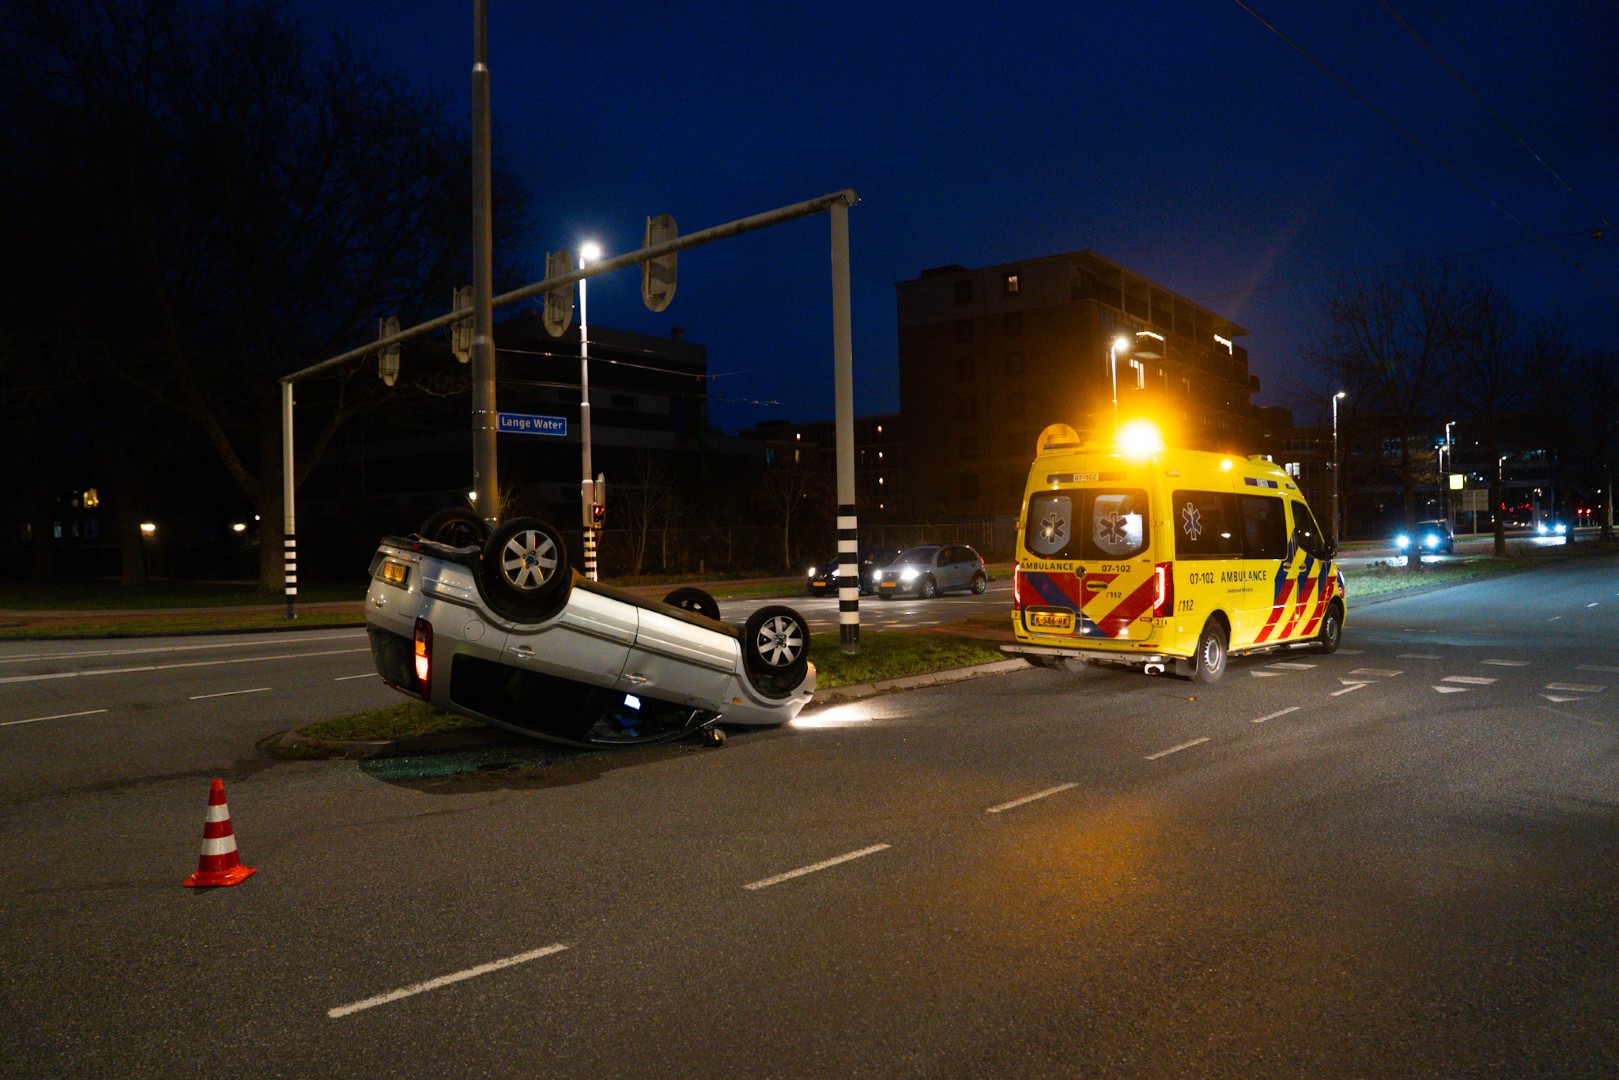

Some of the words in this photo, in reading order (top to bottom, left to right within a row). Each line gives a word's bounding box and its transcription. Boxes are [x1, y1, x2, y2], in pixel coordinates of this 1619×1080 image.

[501, 416, 531, 430] Lange
[533, 418, 563, 430] Water
[1020, 562, 1074, 571] AMBULANCE
[1101, 564, 1131, 573] 07-102
[1189, 572, 1214, 585] 07-102
[1220, 570, 1267, 583] AMBULANCE
